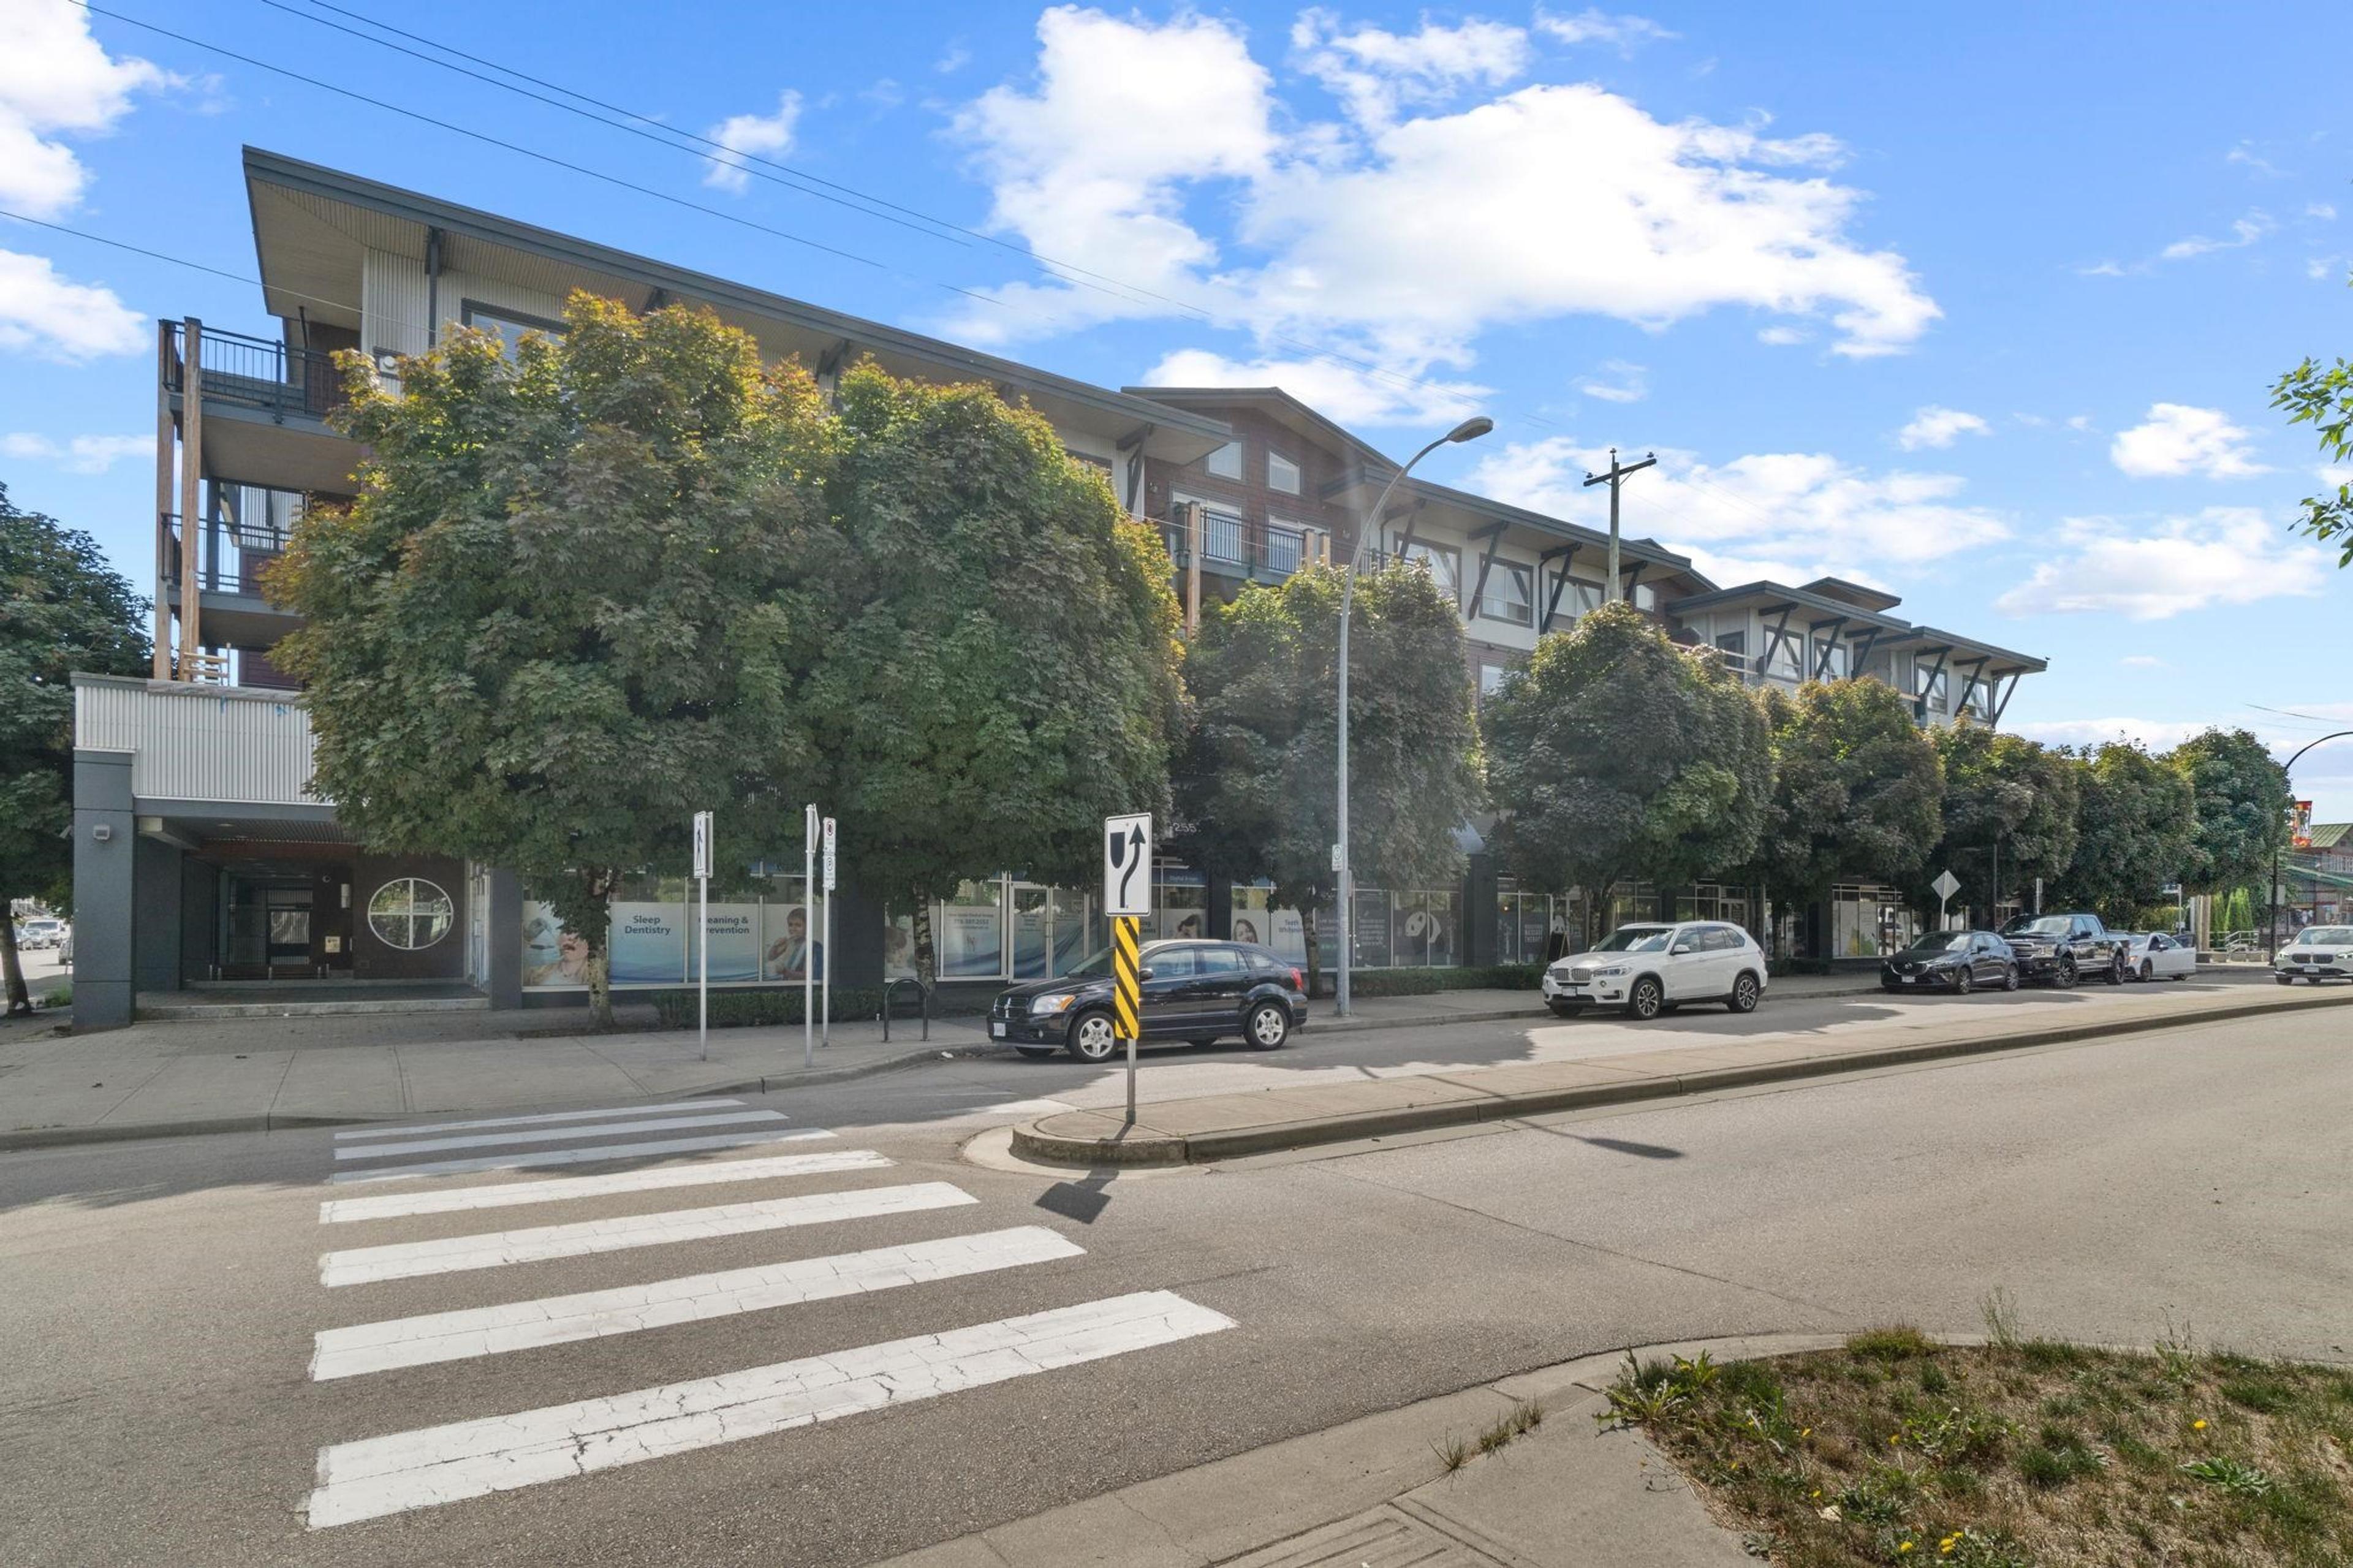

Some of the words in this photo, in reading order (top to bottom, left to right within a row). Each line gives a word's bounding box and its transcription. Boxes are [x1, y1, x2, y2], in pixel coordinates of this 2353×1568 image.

[633, 915, 661, 925] Sleep
[699, 915, 740, 925] eaning
[624, 925, 671, 936] Dentistry
[700, 925, 750, 934] revention
